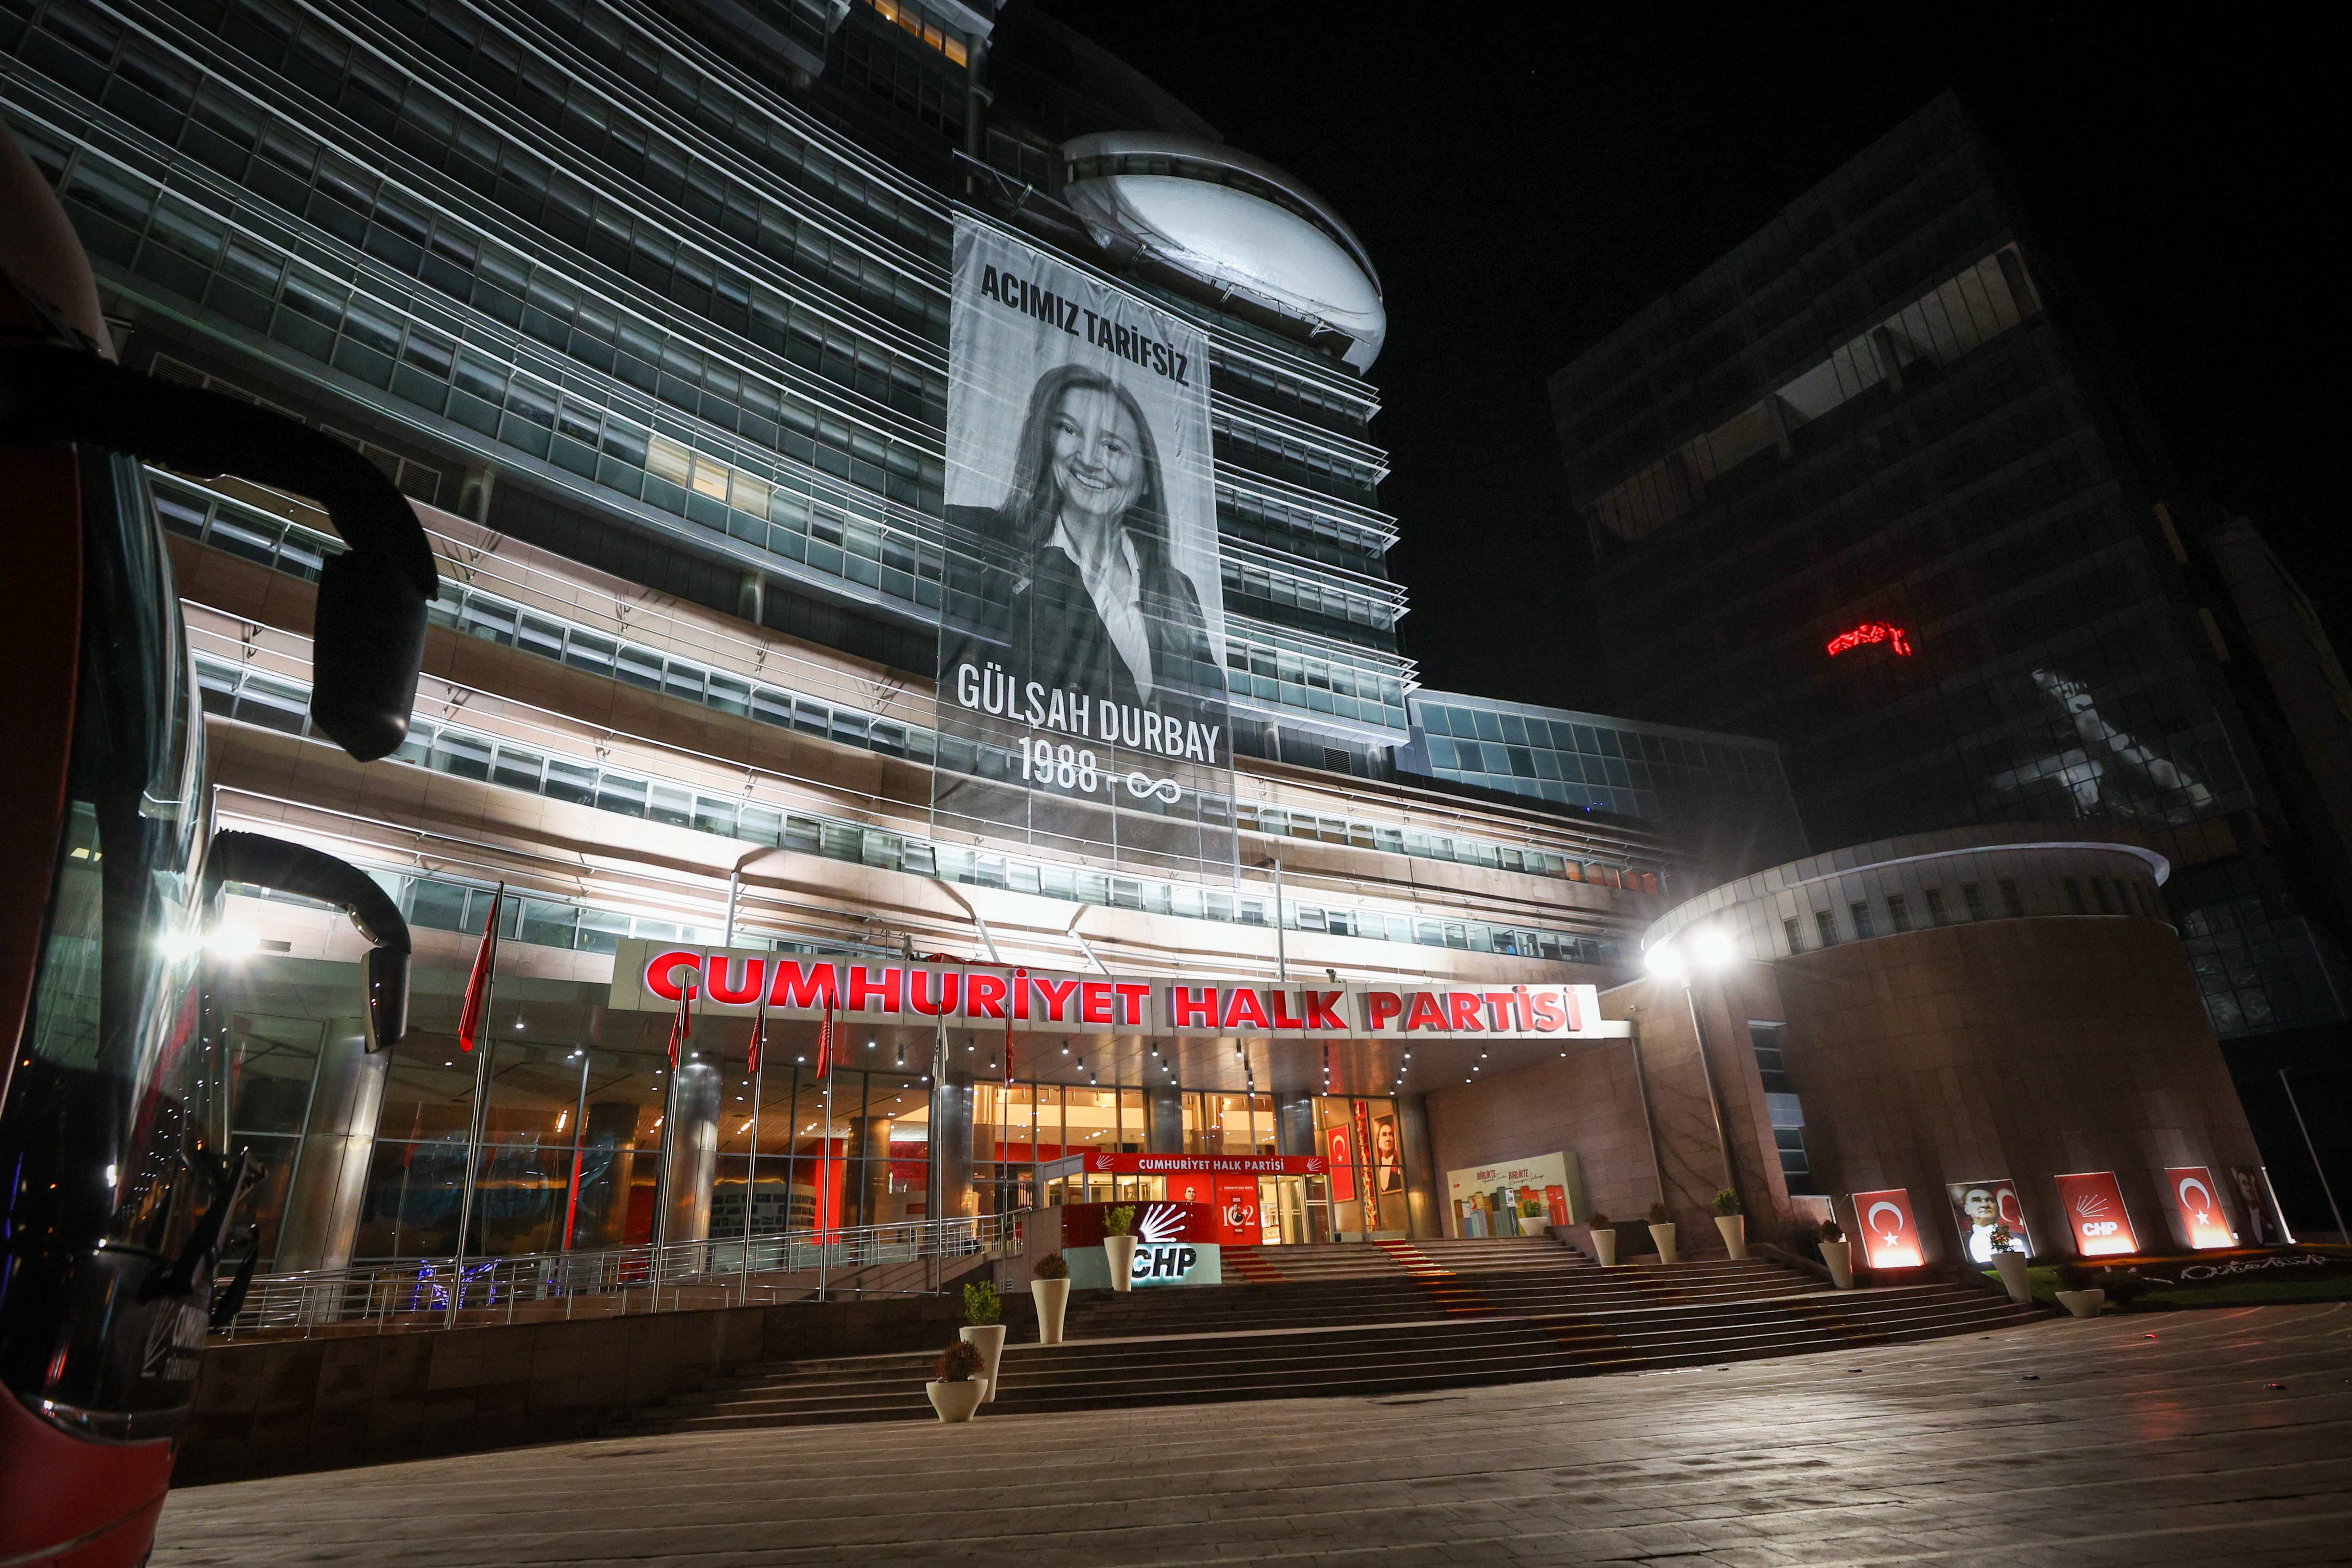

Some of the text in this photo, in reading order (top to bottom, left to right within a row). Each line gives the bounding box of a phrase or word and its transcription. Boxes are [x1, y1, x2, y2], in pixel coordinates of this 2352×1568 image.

[981, 264, 1189, 387] ACIMIZ TARİFSİZ
[958, 661, 1220, 764] GÜLŞAH DURBAY
[1018, 736, 1097, 792] 1988
[647, 951, 1584, 1032] CUMHURİYET HALK PARTİSİ
[1138, 1157, 1284, 1170] CUMHURİYET HALK PARTİSİ
[2082, 1221, 2118, 1237] CHP
[1131, 1247, 1196, 1279] CHP
